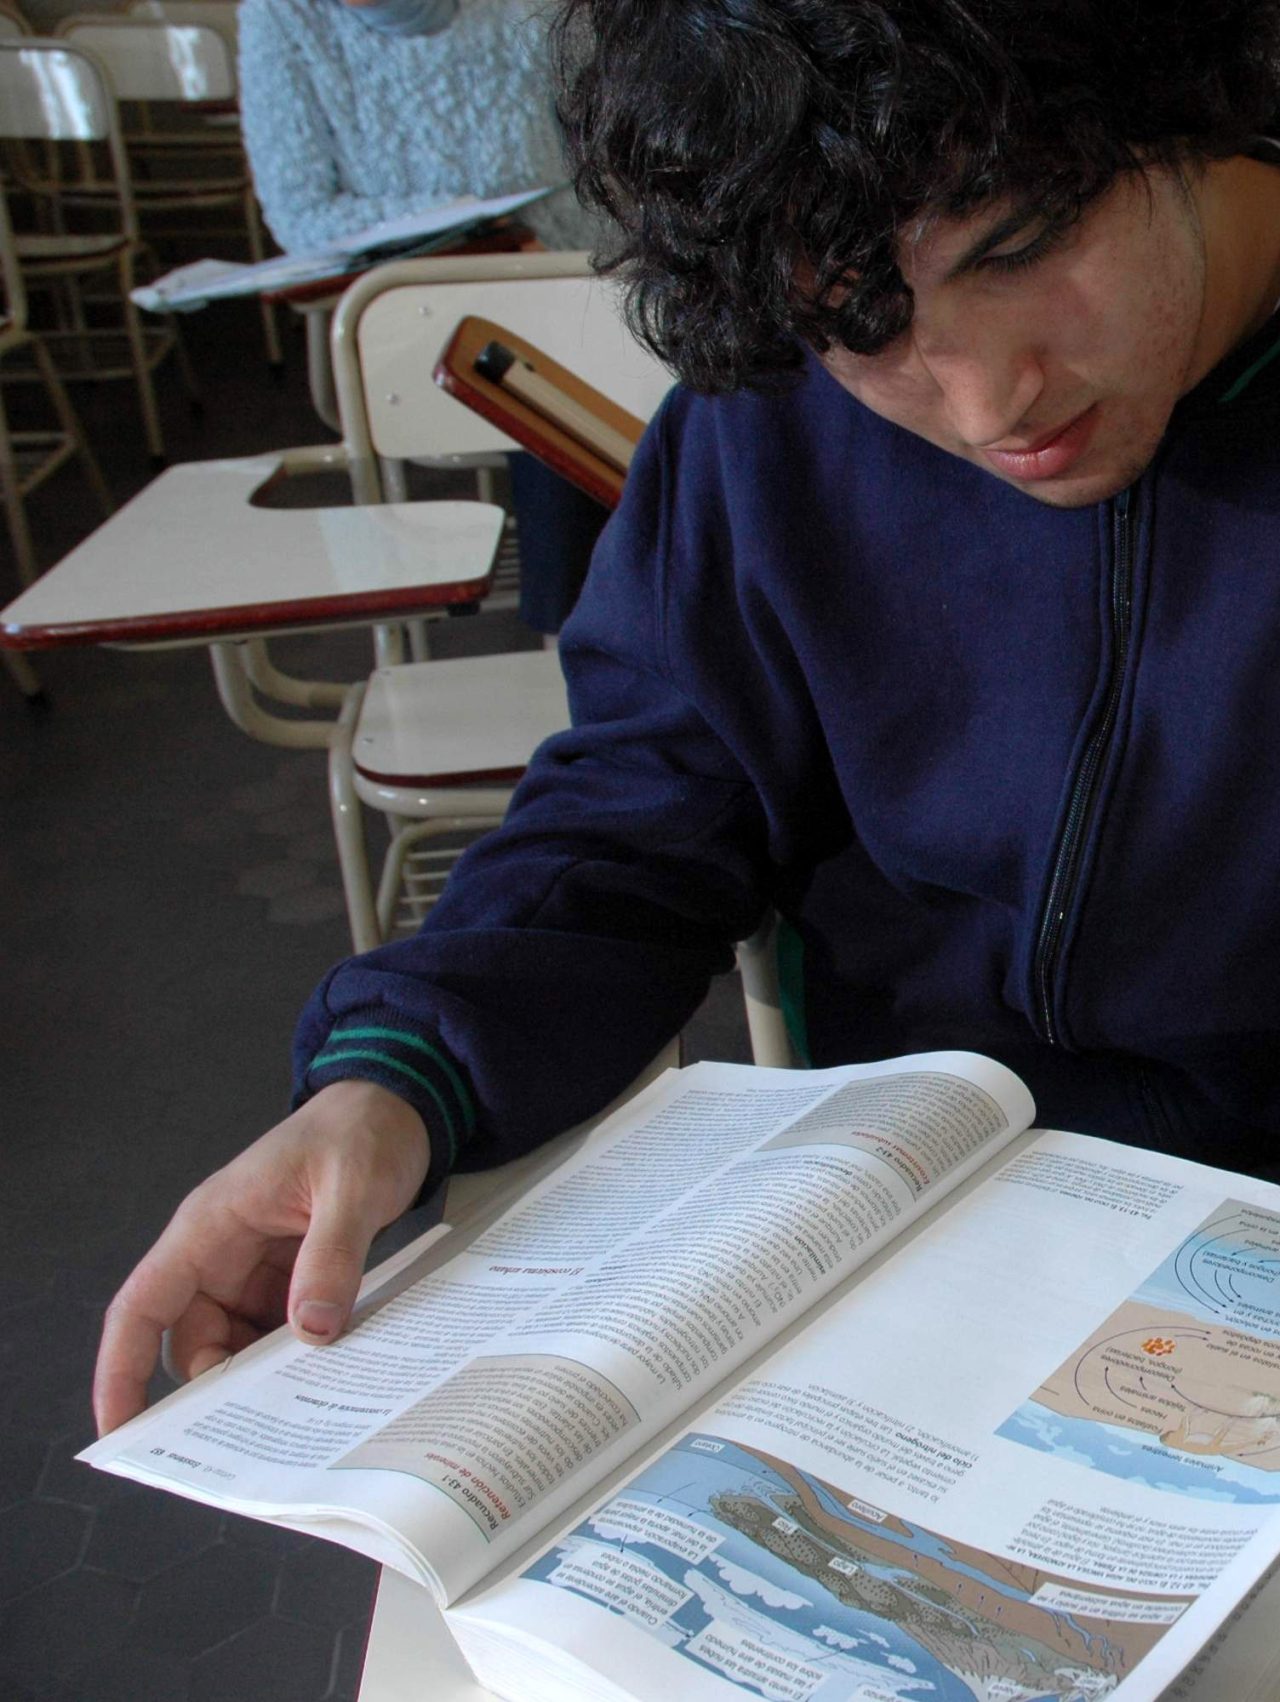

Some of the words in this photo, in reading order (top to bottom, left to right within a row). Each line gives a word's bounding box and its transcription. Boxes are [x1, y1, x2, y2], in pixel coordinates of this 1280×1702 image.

[458, 1468, 473, 1478] de
[461, 1488, 500, 1531] Recuadro
[471, 1477, 512, 1521] Retención
